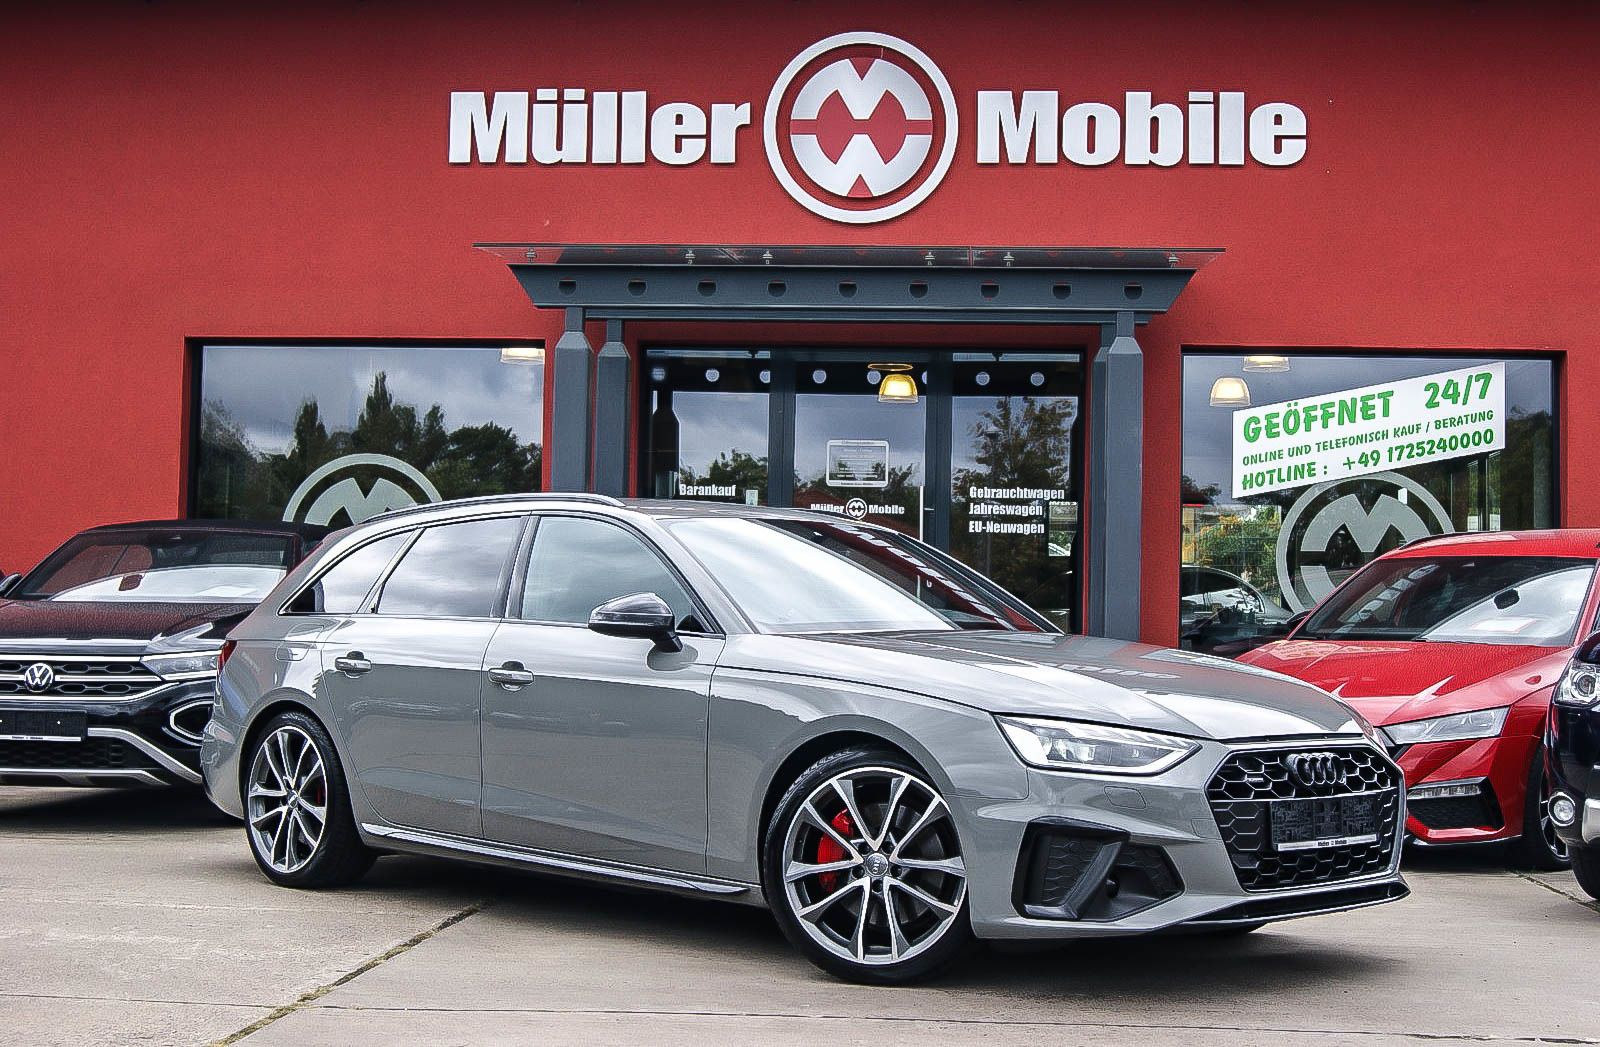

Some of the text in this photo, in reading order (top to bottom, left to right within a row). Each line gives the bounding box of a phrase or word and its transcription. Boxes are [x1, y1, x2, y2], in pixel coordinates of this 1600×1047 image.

[448, 89, 1308, 166] Müller Mobile
[1243, 372, 1493, 443] GEÖFFNET 24/7
[1242, 449, 1284, 466] ONLINE
[1287, 444, 1312, 457] UND
[1315, 429, 1389, 453] TELEFONISCH
[1393, 423, 1422, 438] KAUF
[1434, 409, 1494, 430] BERATUNG
[1241, 461, 1317, 490] HOTLINE
[1342, 449, 1381, 470] +49
[1387, 428, 1494, 463] 1725240000
[679, 483, 737, 497] Barankauf
[969, 486, 1065, 501] Gebrauchtwagen
[810, 503, 905, 515] Müller Mobile
[968, 502, 1043, 517] Jahreswagen
[968, 520, 1045, 535] EU-Neuwagen
